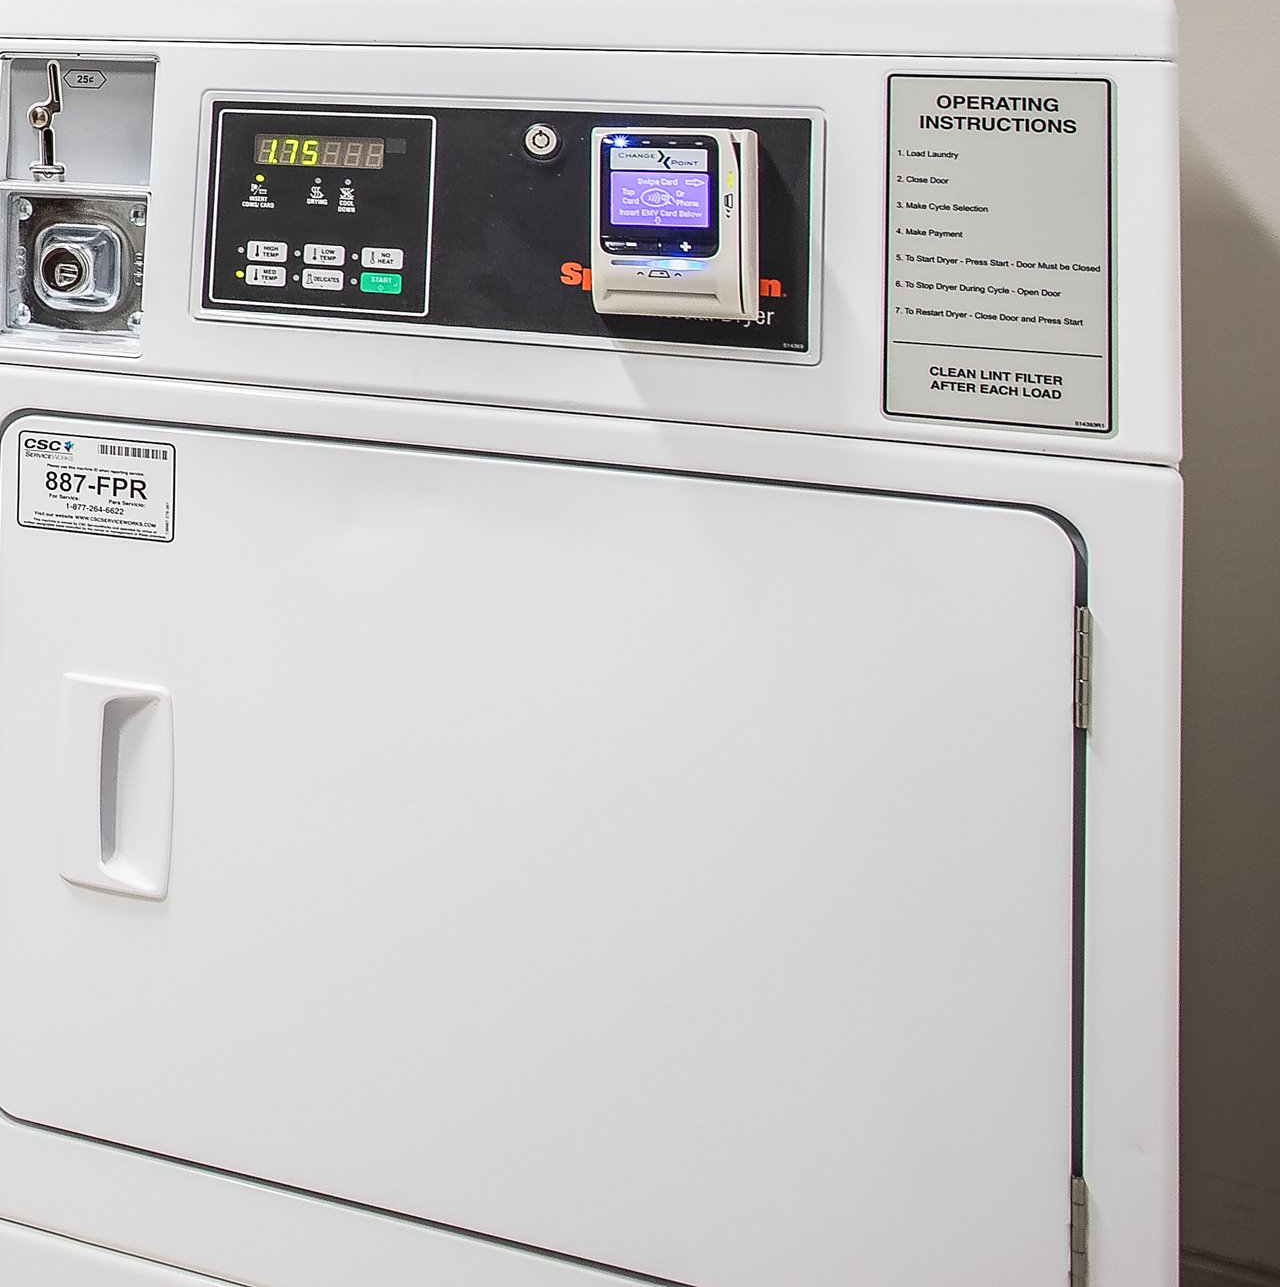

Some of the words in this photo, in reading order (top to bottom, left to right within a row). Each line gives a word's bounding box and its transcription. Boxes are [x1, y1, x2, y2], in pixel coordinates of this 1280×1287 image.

[77, 74, 94, 84] 25¢
[937, 95, 1058, 112] OPERATING
[920, 116, 1076, 133] INSTRUCTIONS
[268, 139, 318, 165] 1.75
[637, 178, 660, 186] Swipe
[660, 178, 678, 186] Card
[906, 228, 926, 236] Make
[929, 230, 962, 238] Payment
[314, 276, 340, 284] DELICATES
[370, 276, 392, 284] START
[930, 367, 976, 378] CLEAN
[981, 370, 1011, 381] LINT
[1016, 373, 1062, 386] FILTER
[931, 380, 975, 392] AFTER
[980, 384, 1018, 396] EACH
[1023, 388, 1061, 399] LOAD
[24, 438, 61, 452] CSC
[46, 471, 147, 500] 887-FPR
[66, 503, 124, 515] 1-877-264-6622
